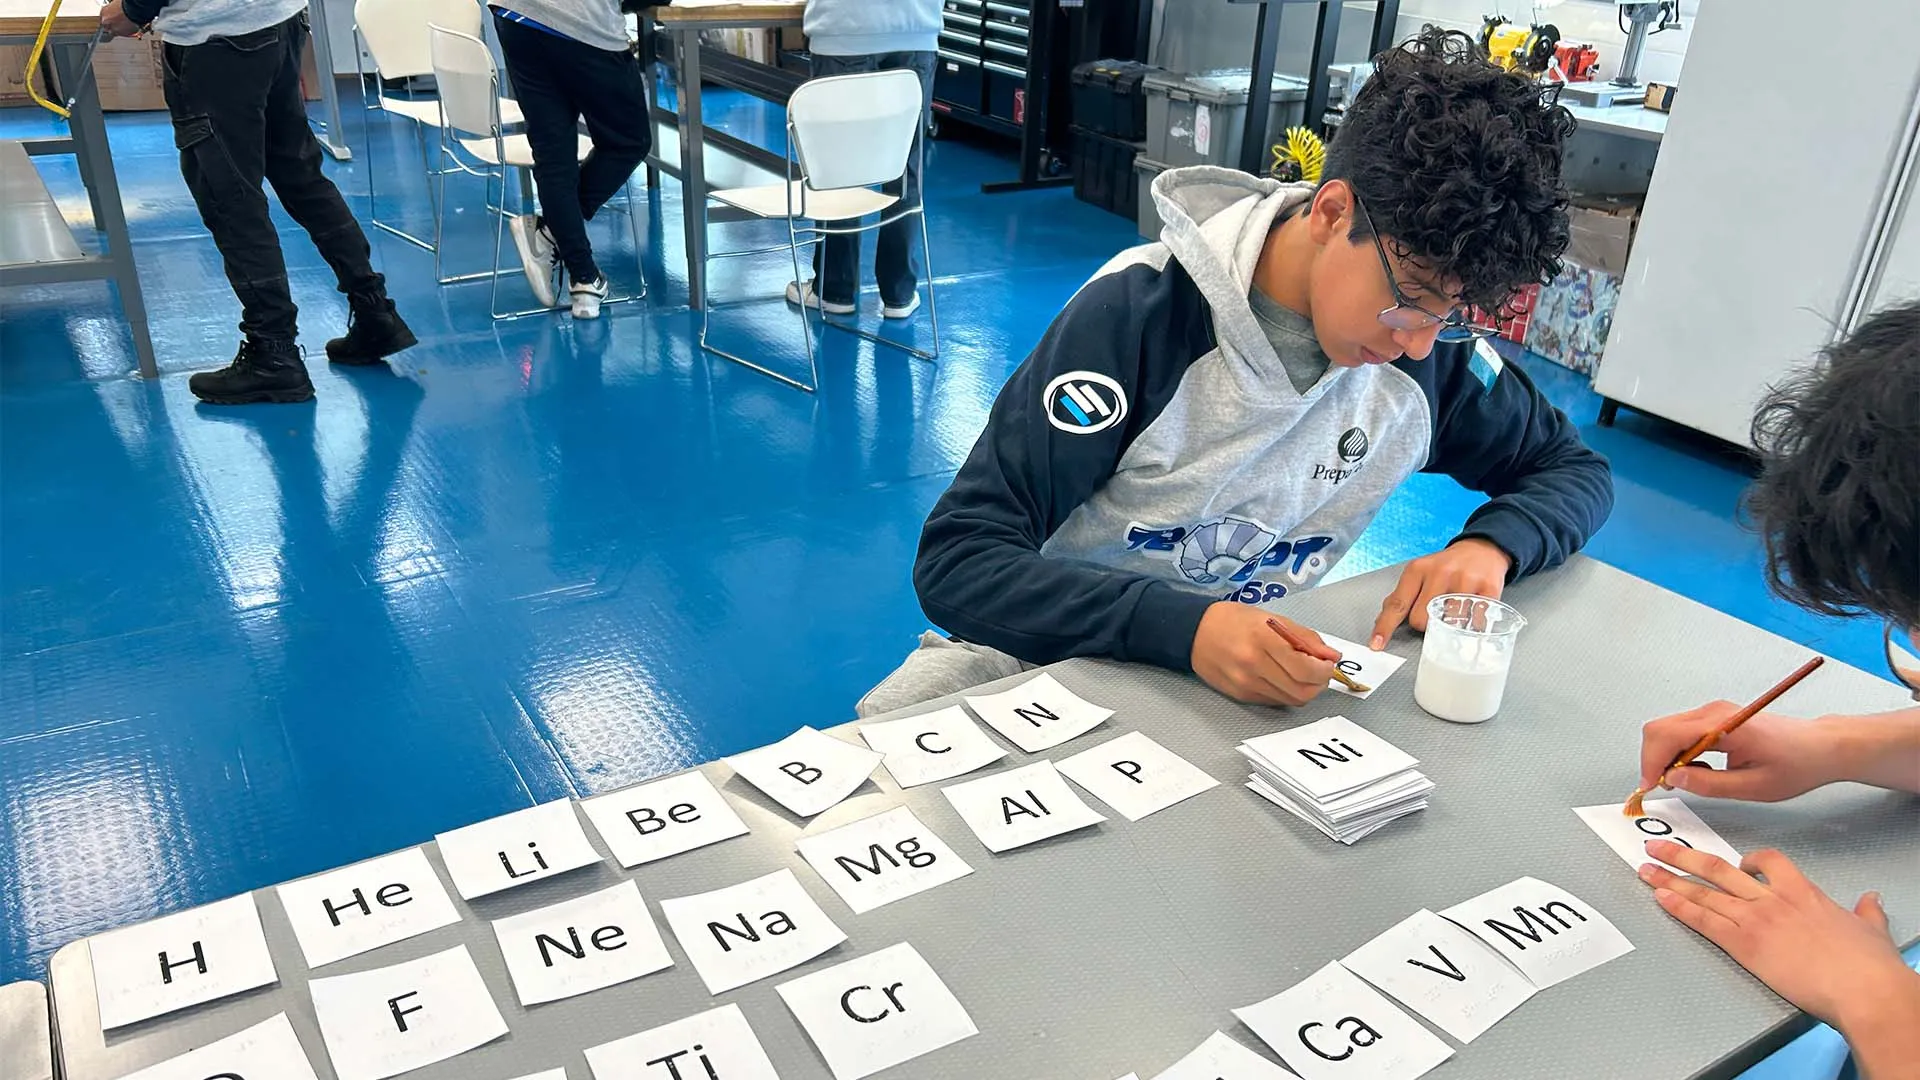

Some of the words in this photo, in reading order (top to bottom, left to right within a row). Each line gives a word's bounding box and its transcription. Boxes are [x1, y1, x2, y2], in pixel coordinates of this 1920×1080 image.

[1336, 660, 1363, 676] e
[1014, 702, 1060, 728] N
[915, 732, 952, 754] C
[1296, 737, 1364, 770] Ni
[780, 761, 823, 785] B
[1110, 760, 1143, 784] P
[624, 801, 702, 836] Be
[1001, 789, 1049, 825] Al
[498, 841, 549, 879] Li
[834, 837, 937, 882] Mg
[322, 881, 414, 927] He
[707, 910, 797, 952] Na
[1484, 898, 1588, 952] Mn
[158, 940, 208, 985] H
[535, 923, 628, 968] Ne
[1407, 944, 1466, 983] V
[387, 990, 424, 1033] F
[840, 981, 906, 1024] Cr
[1298, 1015, 1383, 1062] Ca
[645, 1044, 720, 1080] Ti
